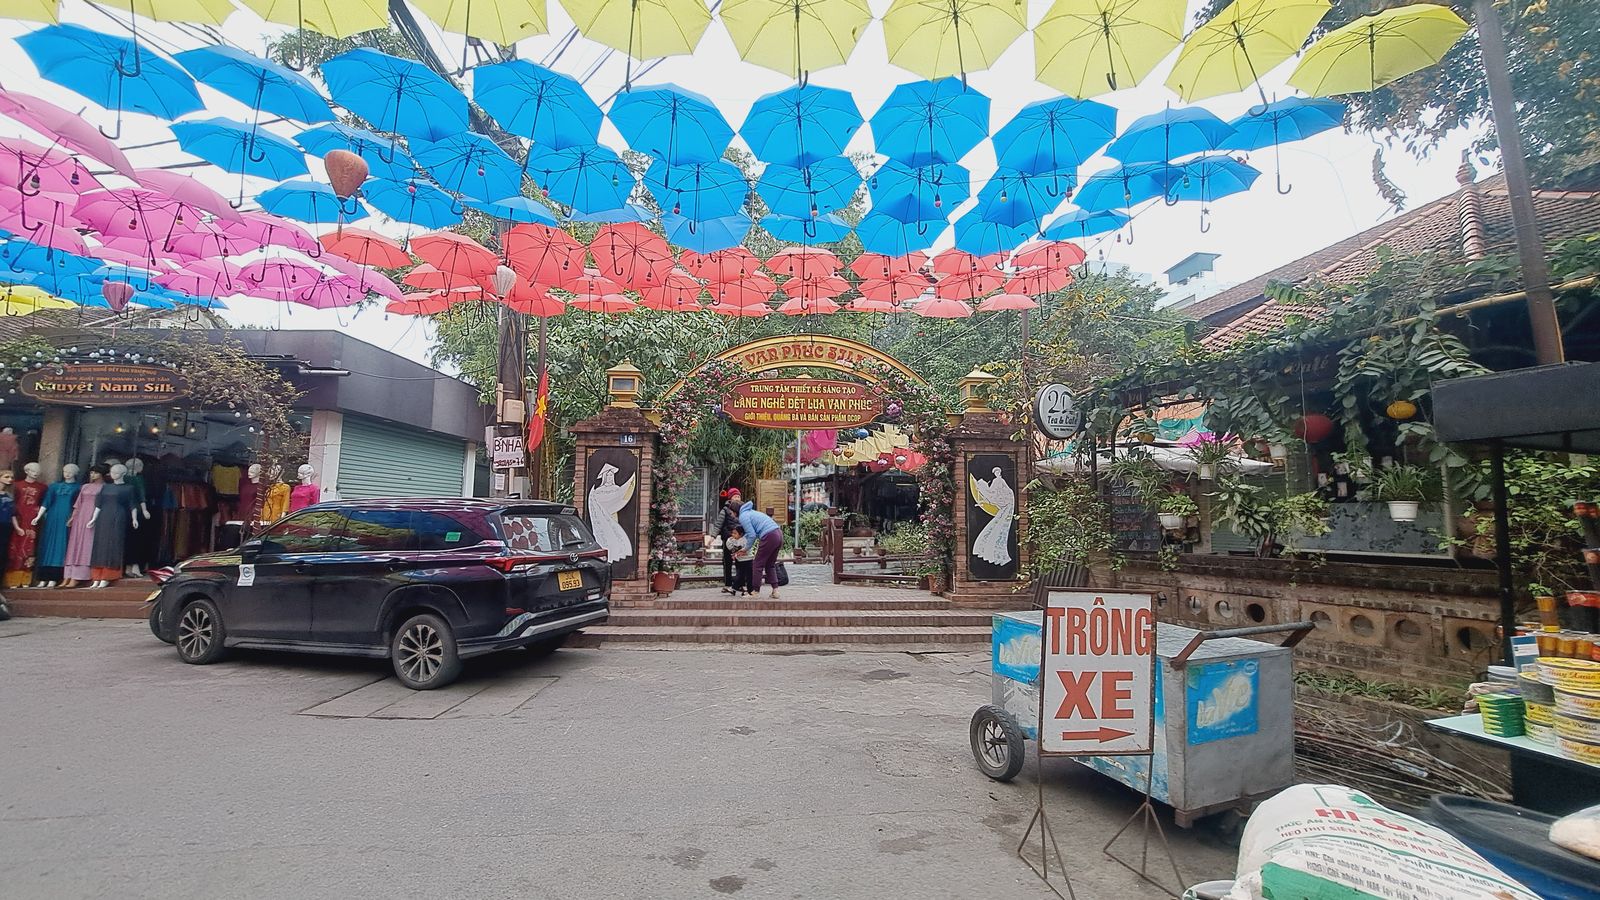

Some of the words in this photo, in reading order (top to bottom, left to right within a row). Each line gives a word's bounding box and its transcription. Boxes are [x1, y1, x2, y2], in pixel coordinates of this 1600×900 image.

[100, 382, 138, 393] Nam
[144, 381, 176, 393] Silk
[750, 384, 774, 393] TRUNG
[775, 383, 790, 393] TÂM
[791, 383, 811, 393] THIẾT
[812, 383, 822, 393] KẾ
[822, 384, 842, 394] SÁNG
[842, 386, 856, 396] TẠO
[734, 394, 758, 408] LÀNG
[760, 393, 786, 409] NGHỀ
[807, 398, 825, 412] LỤA
[828, 398, 846, 412] VẠN
[800, 412, 807, 421] VÀ
[1047, 415, 1058, 424] Tea
[1058, 415, 1064, 424] &
[624, 434, 634, 443] 16
[1046, 597, 1152, 656] TRÔNG
[1054, 671, 1134, 719] XE
[1281, 828, 1301, 837] HEO
